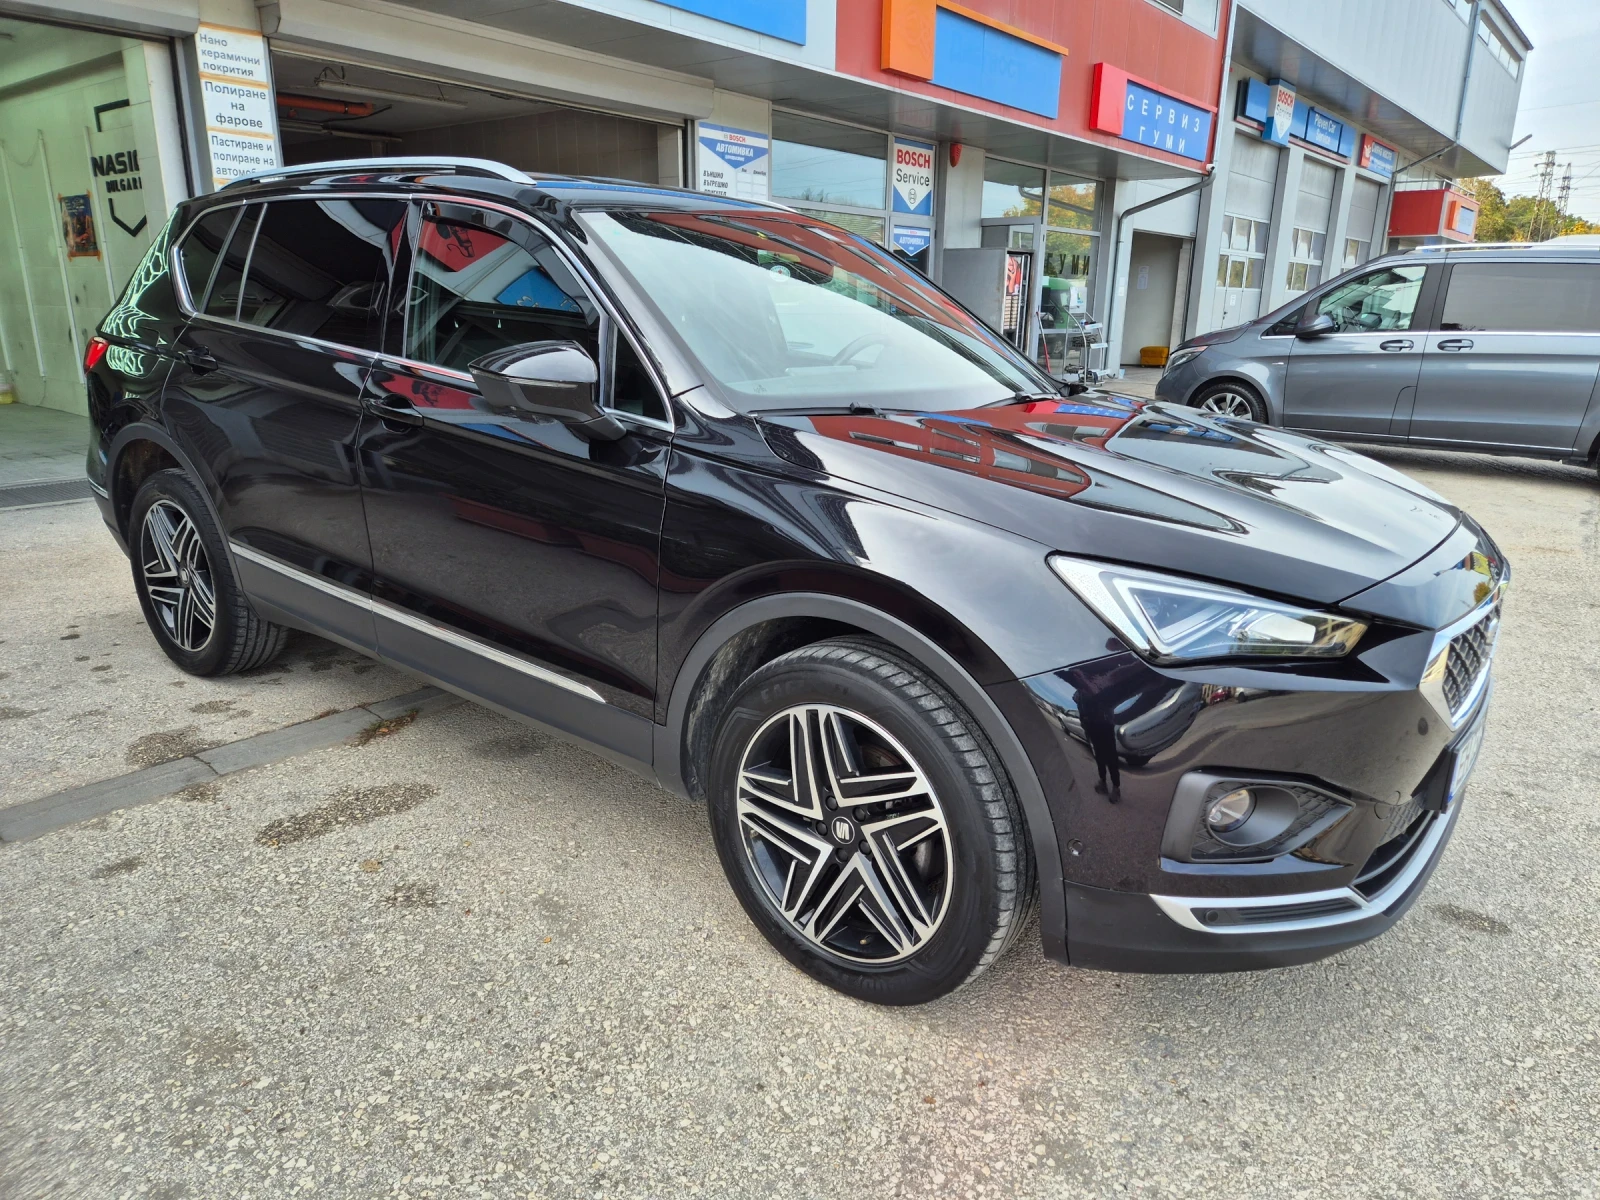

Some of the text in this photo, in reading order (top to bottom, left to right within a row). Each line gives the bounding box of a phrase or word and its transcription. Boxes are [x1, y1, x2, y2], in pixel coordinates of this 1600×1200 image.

[200, 33, 228, 47] Нано
[201, 49, 261, 66] керамични
[202, 61, 254, 77] покрития
[204, 81, 267, 100] Полиране
[1277, 89, 1294, 109] BOSCH
[230, 102, 245, 112] на
[1127, 94, 1200, 133] СЕРВИЗ
[1275, 103, 1292, 121] Service
[215, 114, 263, 129] фарове
[211, 135, 273, 152] Пастиране и
[728, 134, 746, 143] BOSCH
[1139, 126, 1186, 153] ГУМИ
[715, 142, 754, 157] АВТОМИВКА
[213, 151, 275, 166] полиране на
[896, 148, 931, 169] BOSCH
[895, 167, 930, 187] Service
